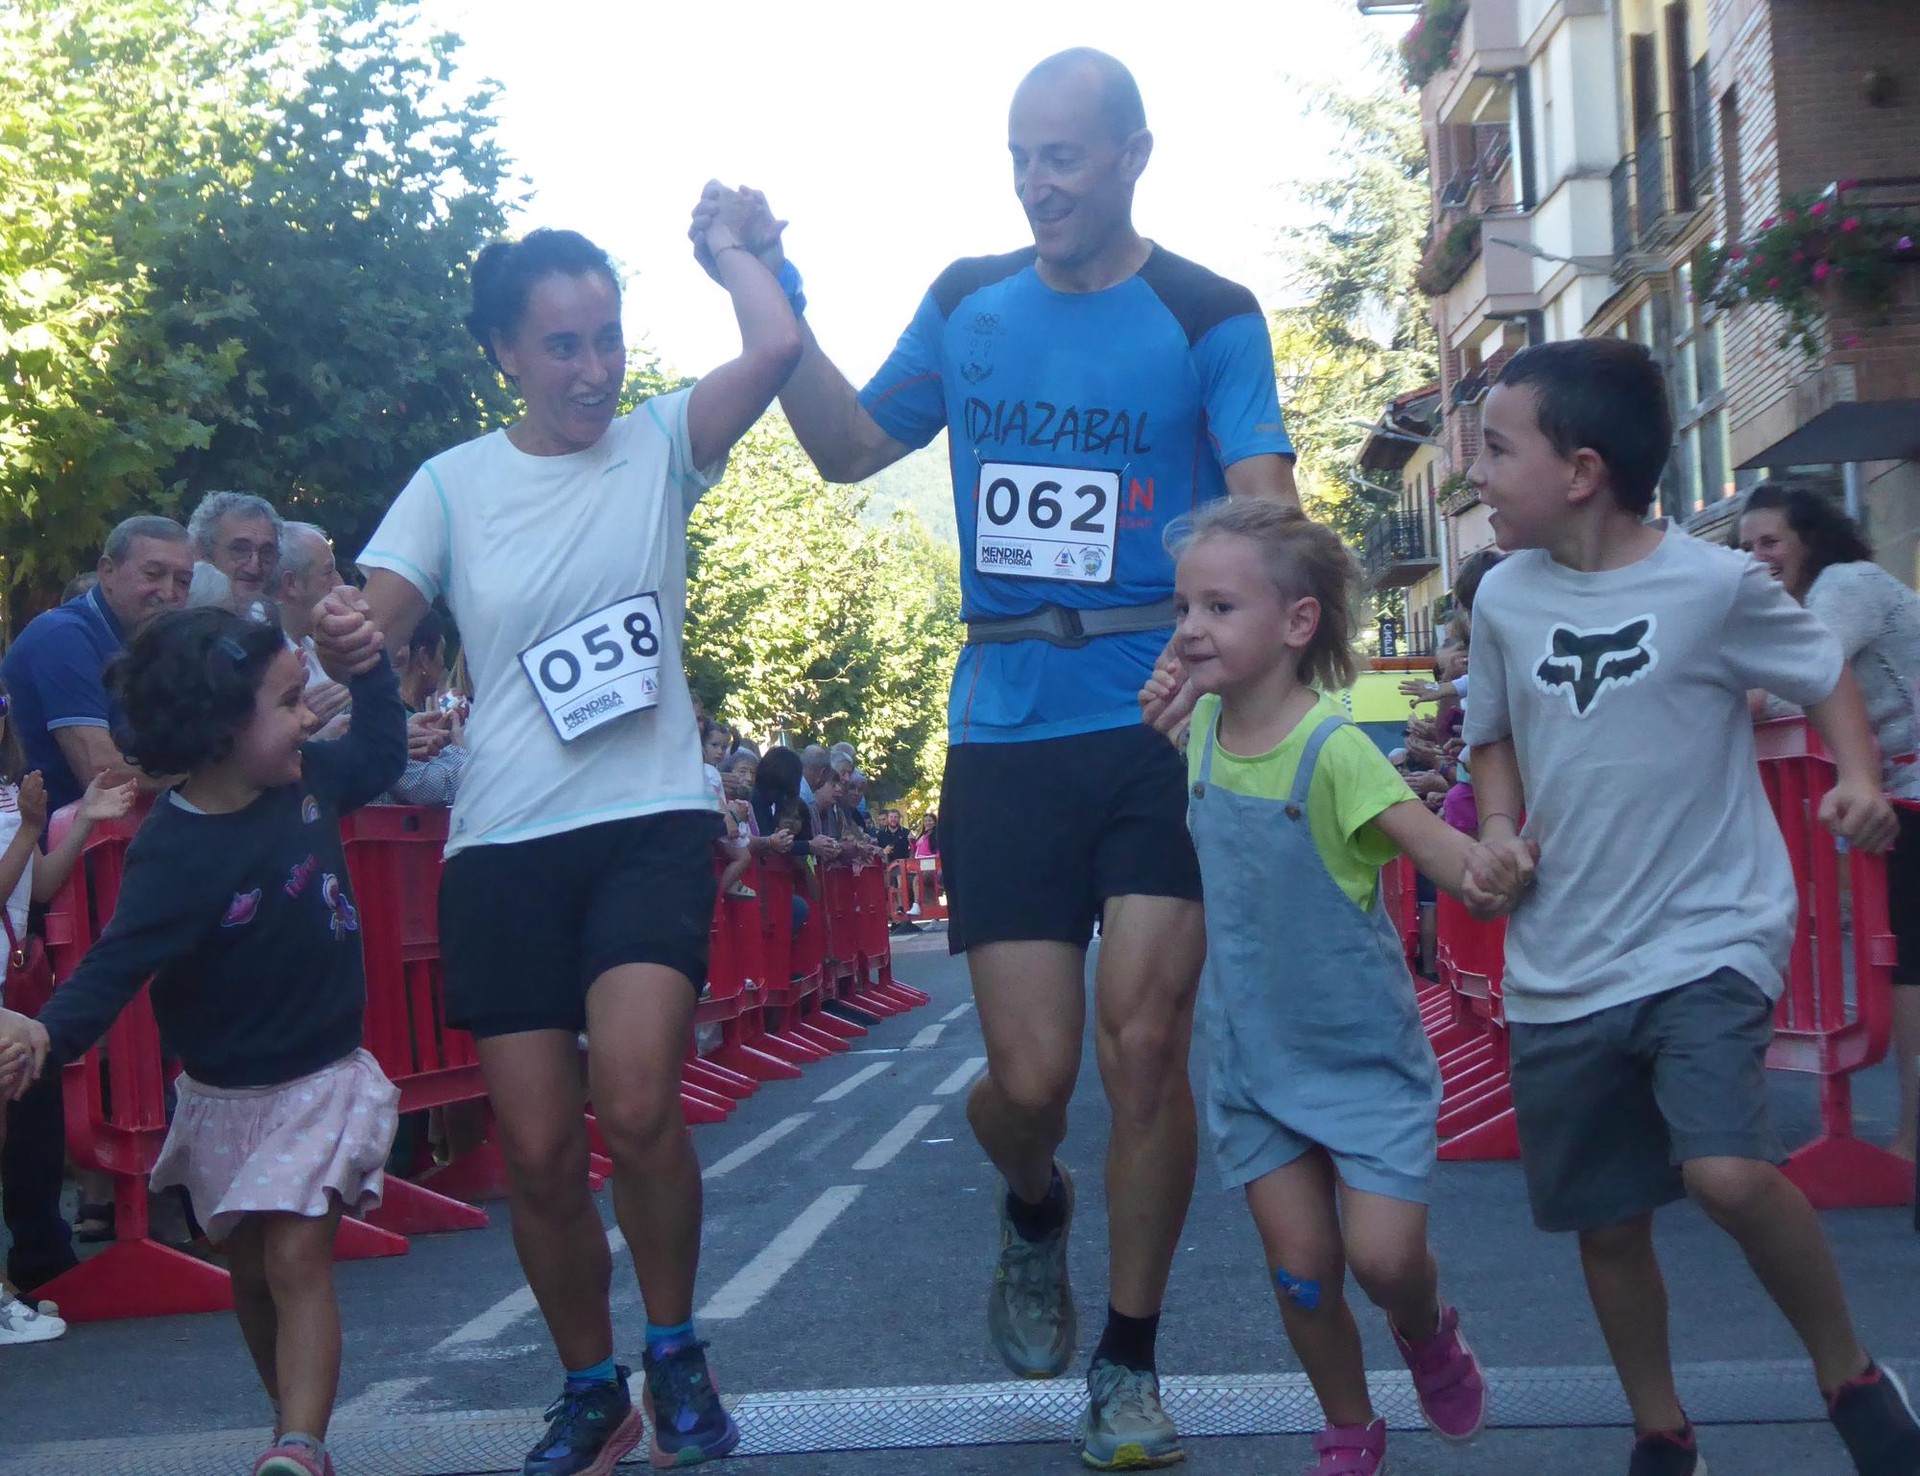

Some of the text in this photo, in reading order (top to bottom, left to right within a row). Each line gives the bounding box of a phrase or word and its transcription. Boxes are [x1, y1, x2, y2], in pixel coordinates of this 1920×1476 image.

[964, 397, 1152, 455] IDIAZABAL
[985, 477, 1107, 534] 062
[981, 546, 1033, 560] MENDIRA
[981, 556, 998, 564] JOAN
[999, 557, 1032, 567] ETORRIA
[539, 612, 659, 693] 058
[562, 690, 622, 725] MENDIRA
